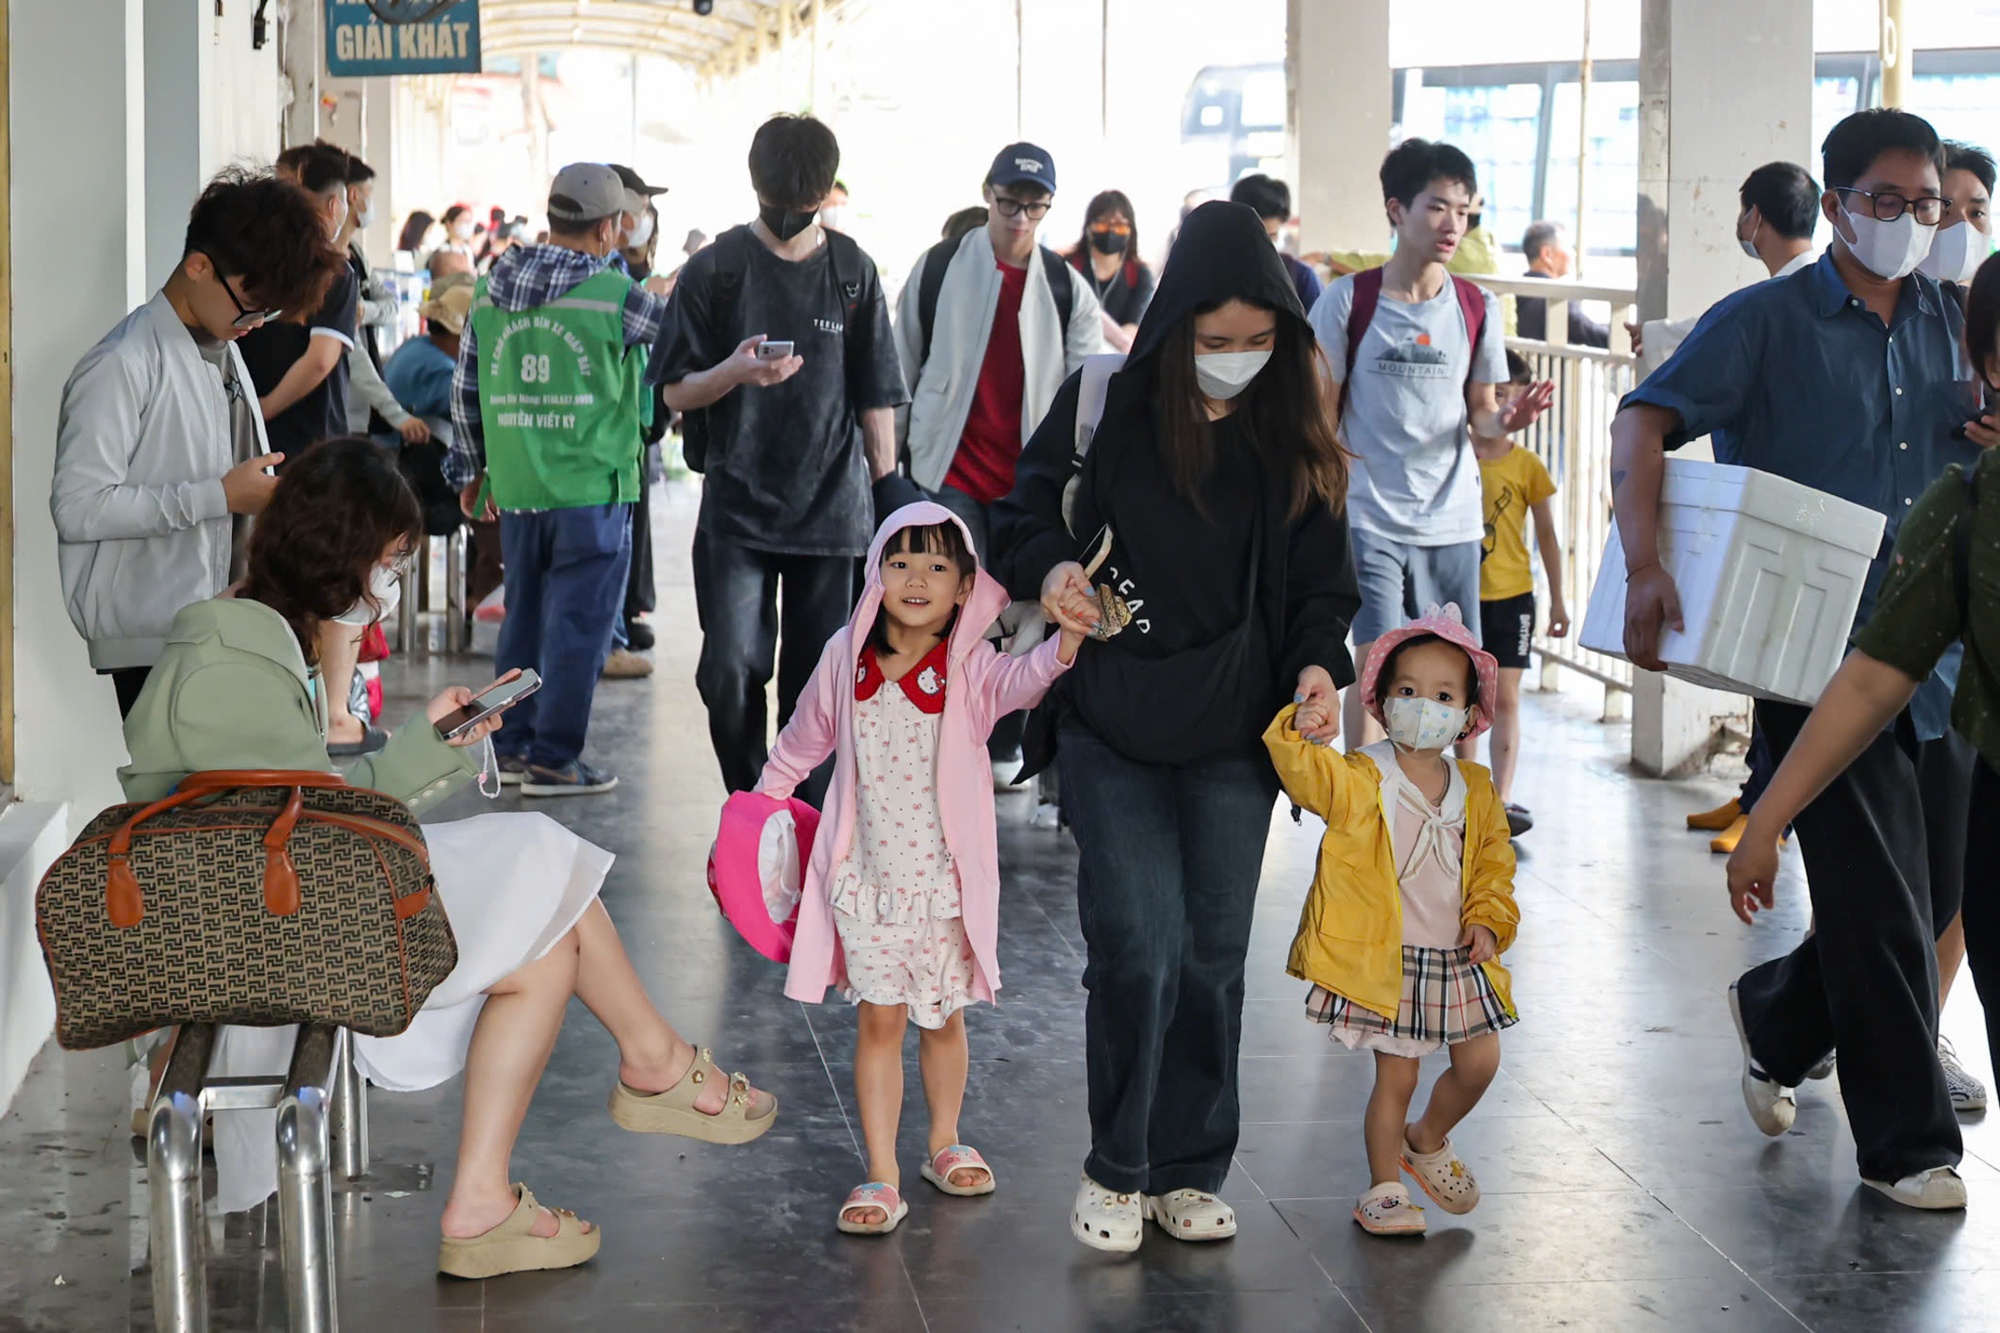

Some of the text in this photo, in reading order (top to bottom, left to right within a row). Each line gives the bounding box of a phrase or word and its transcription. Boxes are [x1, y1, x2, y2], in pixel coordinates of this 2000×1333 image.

[336, 13, 470, 61] GIẢI KHÁT
[520, 353, 550, 384] 89
[1378, 361, 1445, 376] MOUNTAIN
[1518, 613, 1531, 656] BATMAN
